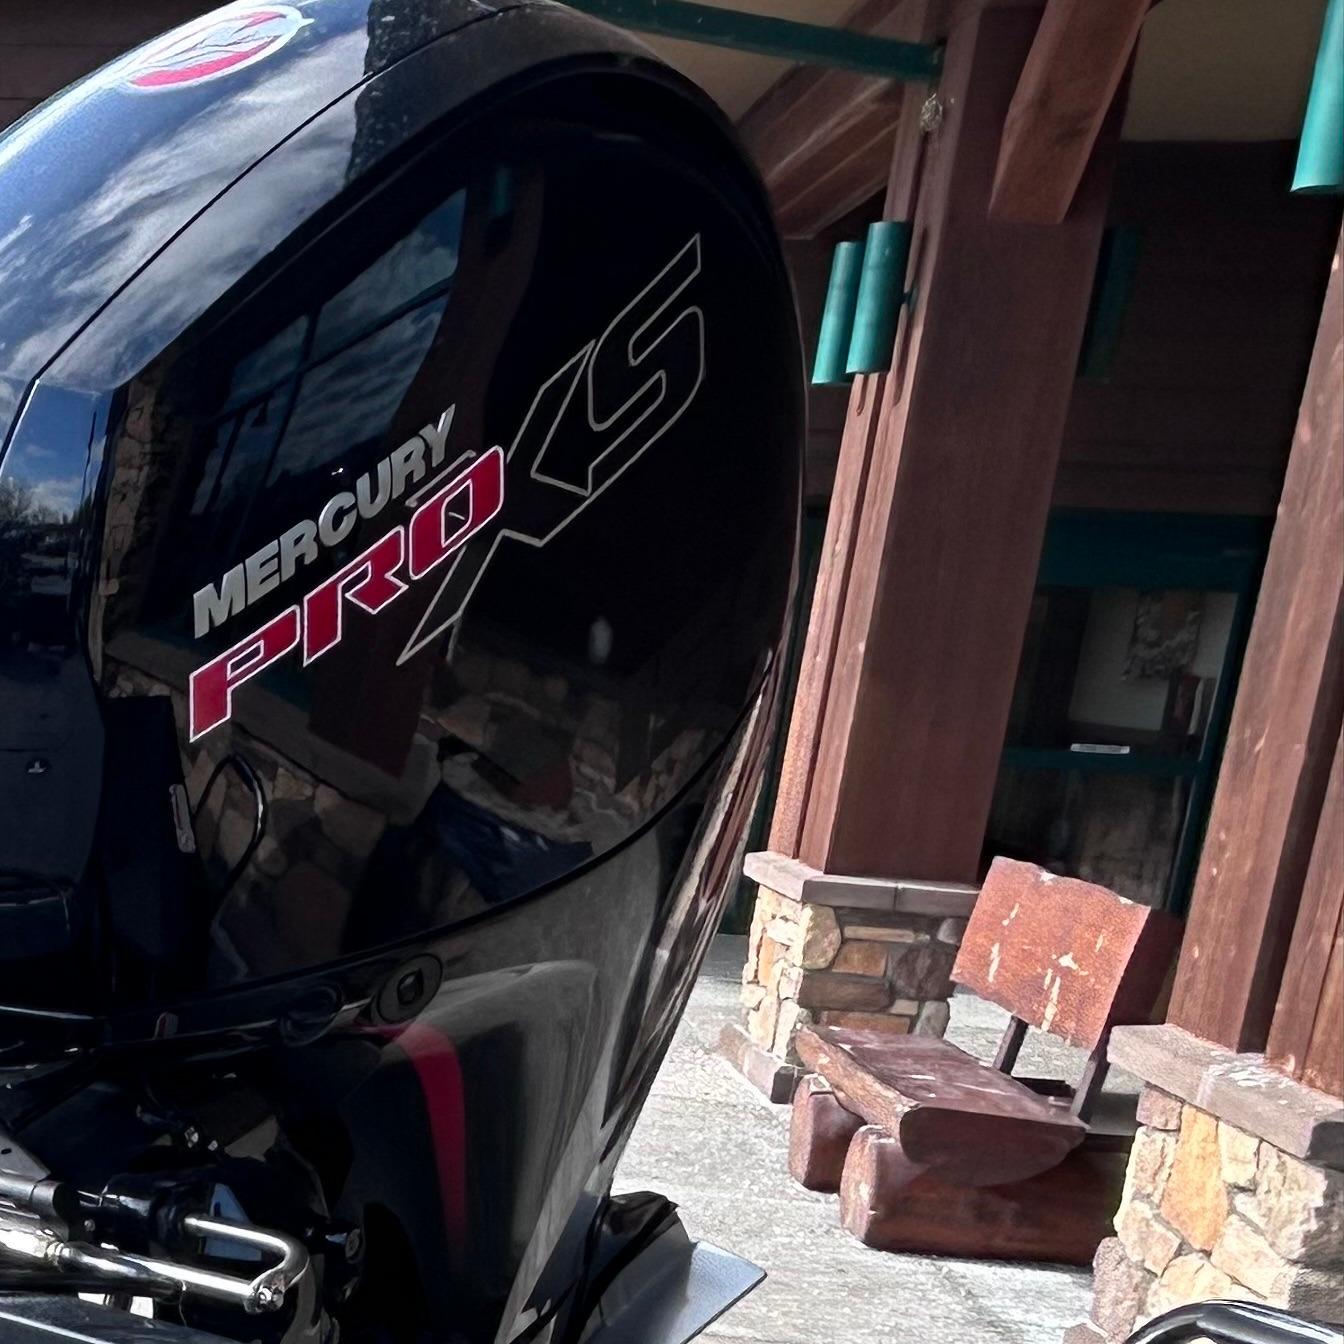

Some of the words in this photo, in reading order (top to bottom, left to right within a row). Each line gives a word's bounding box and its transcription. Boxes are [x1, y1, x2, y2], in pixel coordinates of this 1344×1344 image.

[189, 445, 505, 742] PRO
[396, 233, 706, 665] XS
[193, 404, 456, 638] MERCURY
